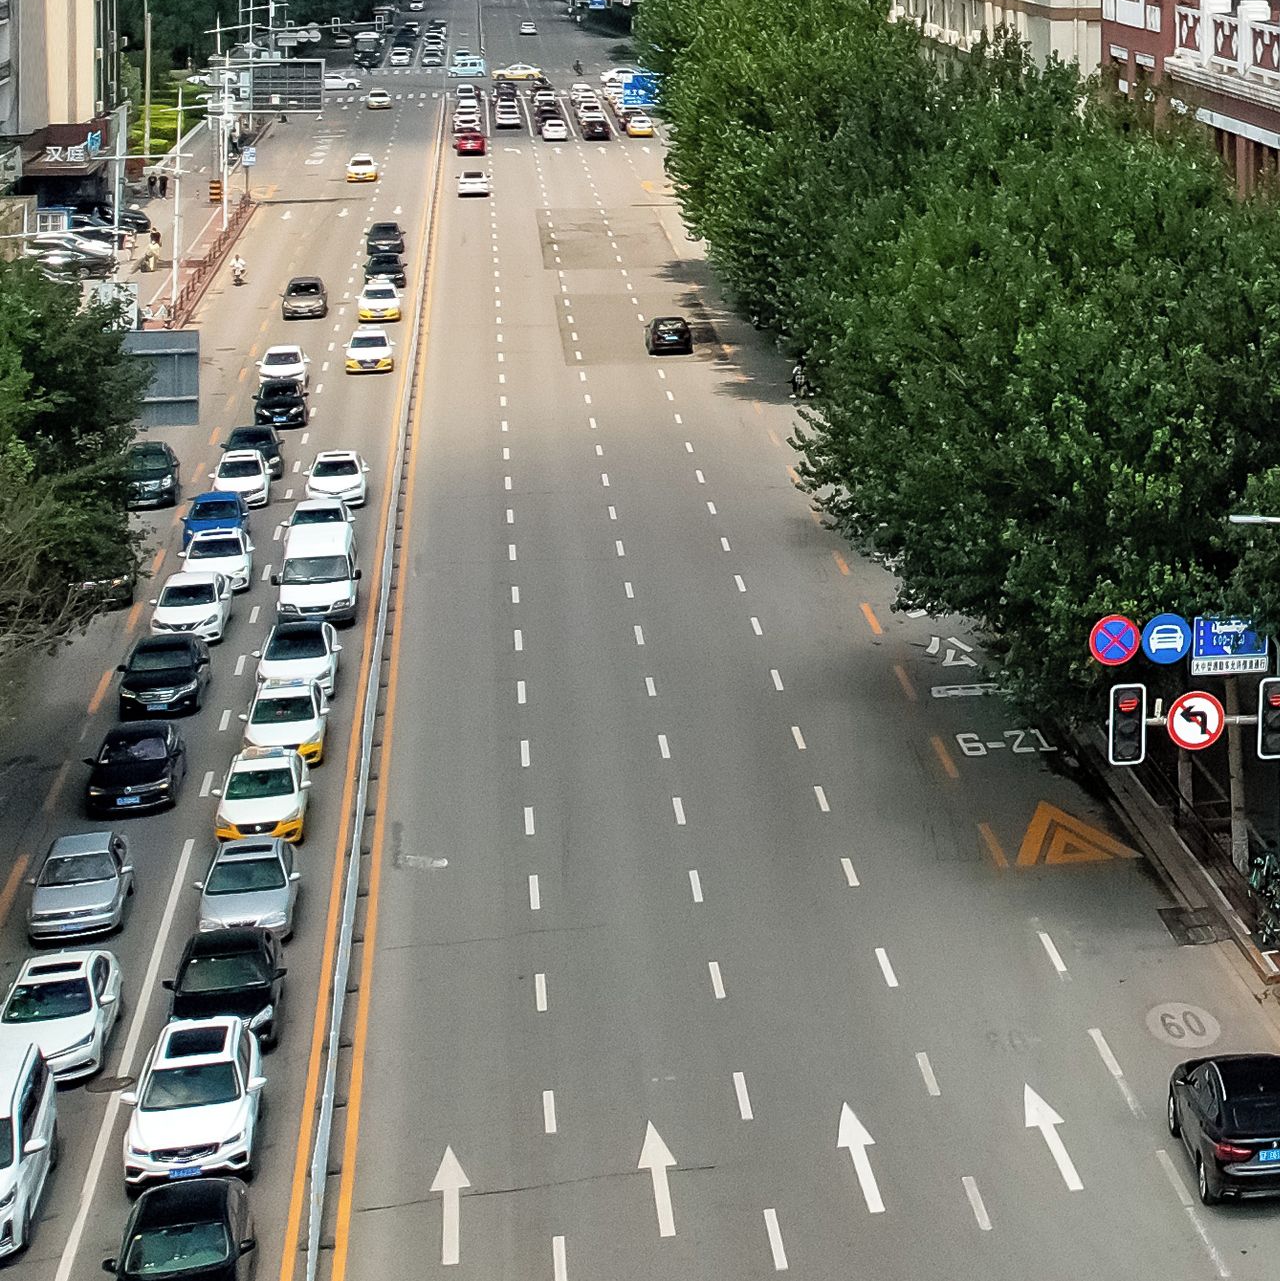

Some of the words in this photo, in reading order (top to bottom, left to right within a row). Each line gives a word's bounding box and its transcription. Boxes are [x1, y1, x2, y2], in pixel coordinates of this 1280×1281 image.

[45, 146, 85, 162] 汉庭
[955, 728, 1058, 756] 6-21
[1160, 1010, 1207, 1040] 60
